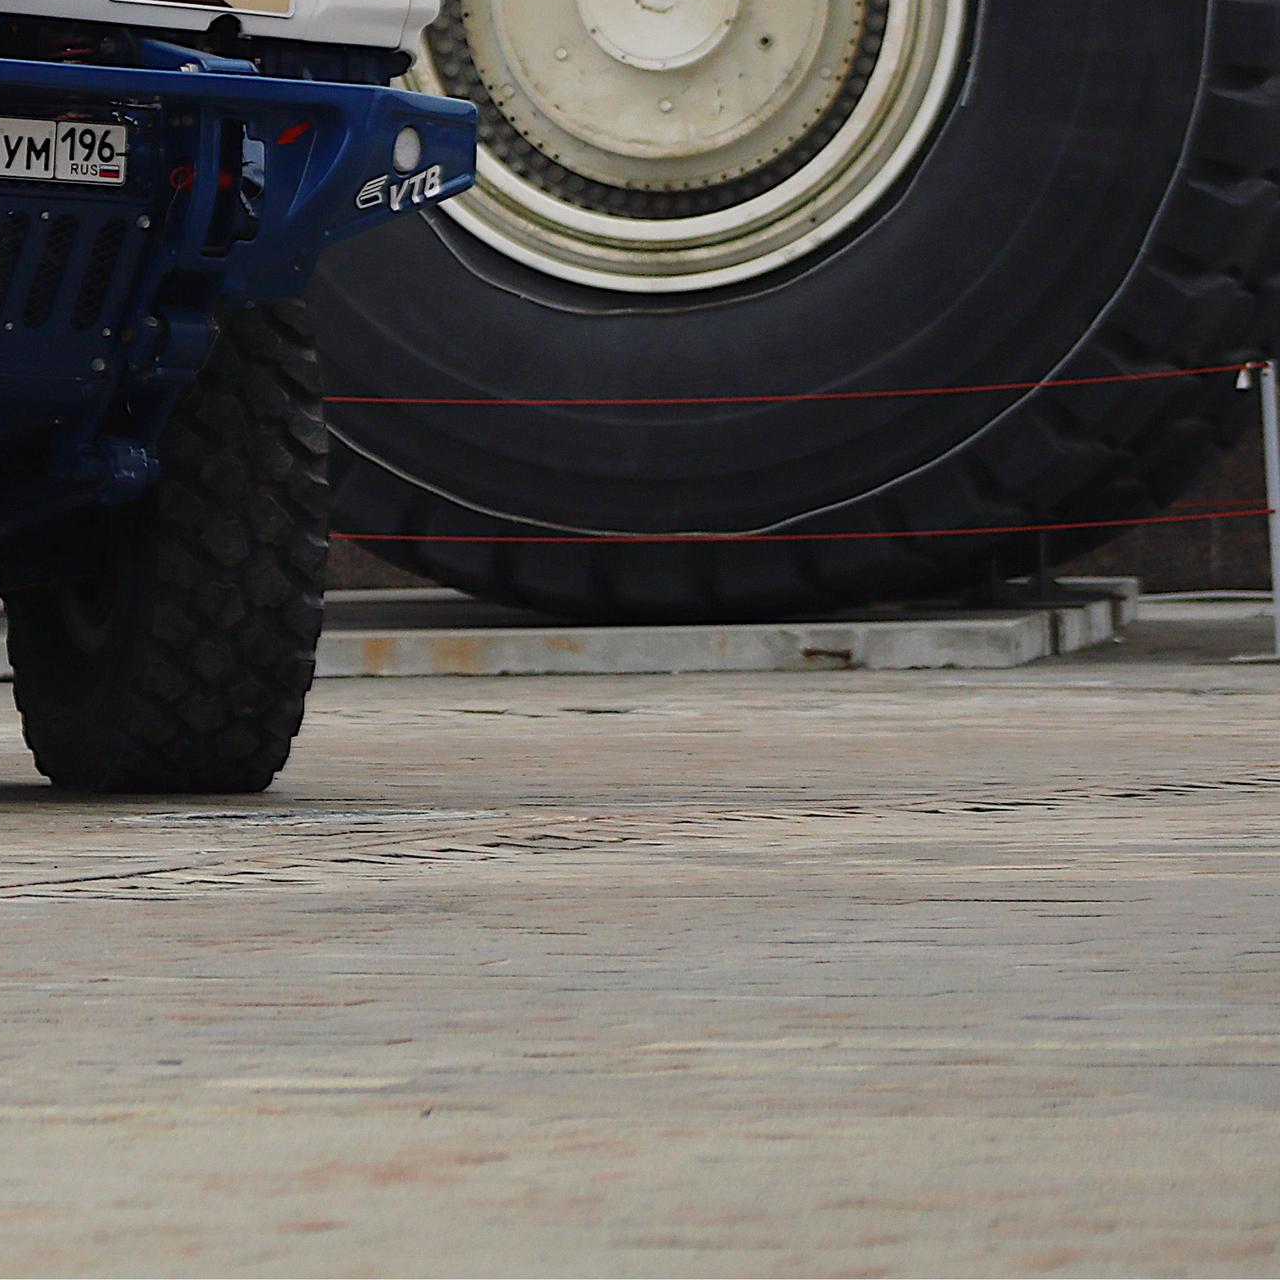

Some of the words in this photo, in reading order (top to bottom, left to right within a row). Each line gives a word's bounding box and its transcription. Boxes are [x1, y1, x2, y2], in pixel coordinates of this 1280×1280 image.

[61, 127, 115, 163] 196
[70, 163, 99, 176] RUS
[389, 164, 441, 212] VTB
